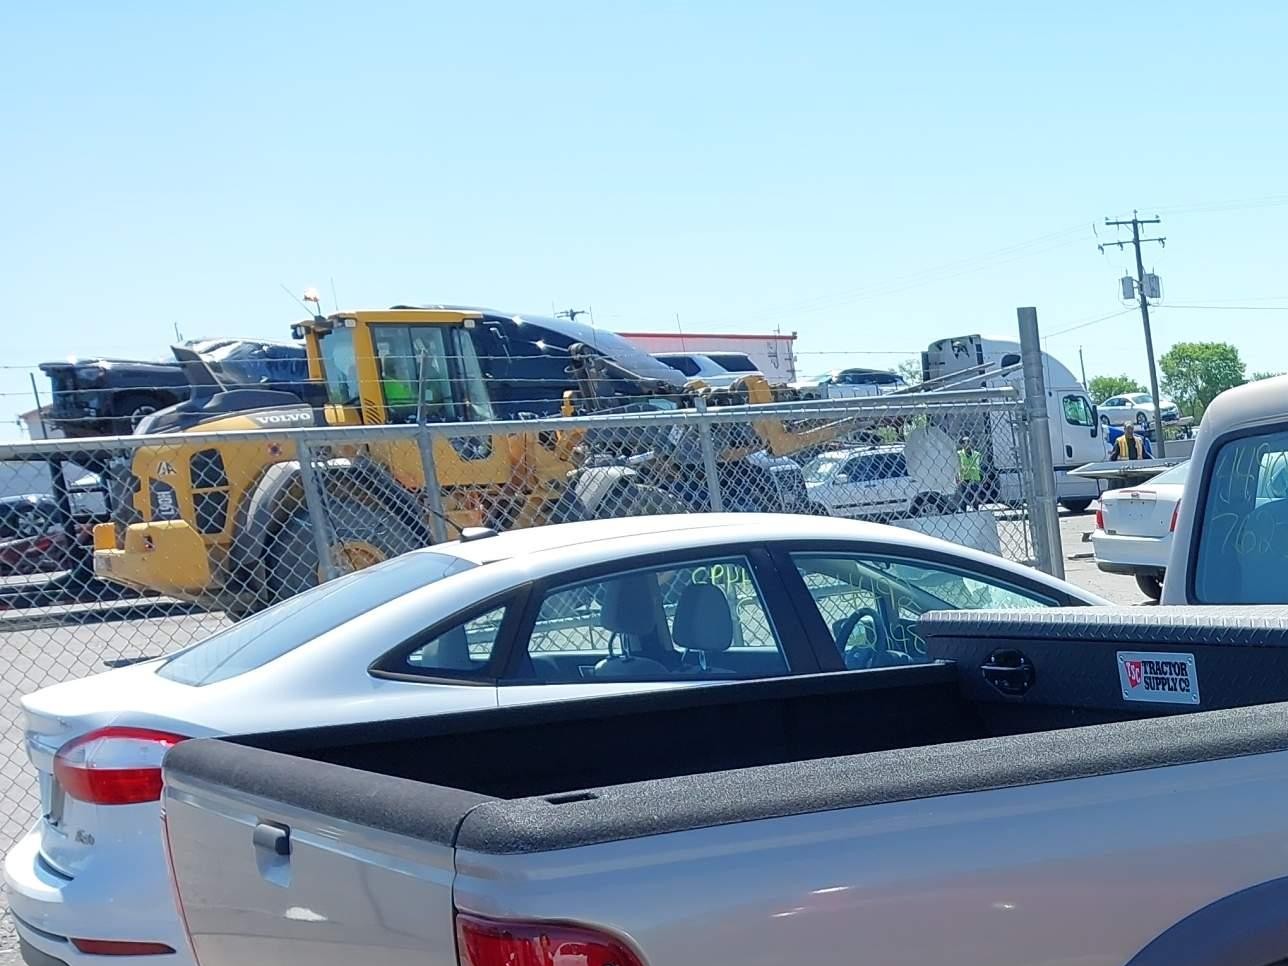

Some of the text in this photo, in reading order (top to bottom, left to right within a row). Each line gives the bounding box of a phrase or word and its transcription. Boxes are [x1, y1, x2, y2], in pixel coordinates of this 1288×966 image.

[256, 412, 311, 425] VOLVO
[1125, 661, 1141, 684] TSC
[1142, 660, 1189, 677] TRACTOR
[1144, 676, 1179, 692] SUPPLY
